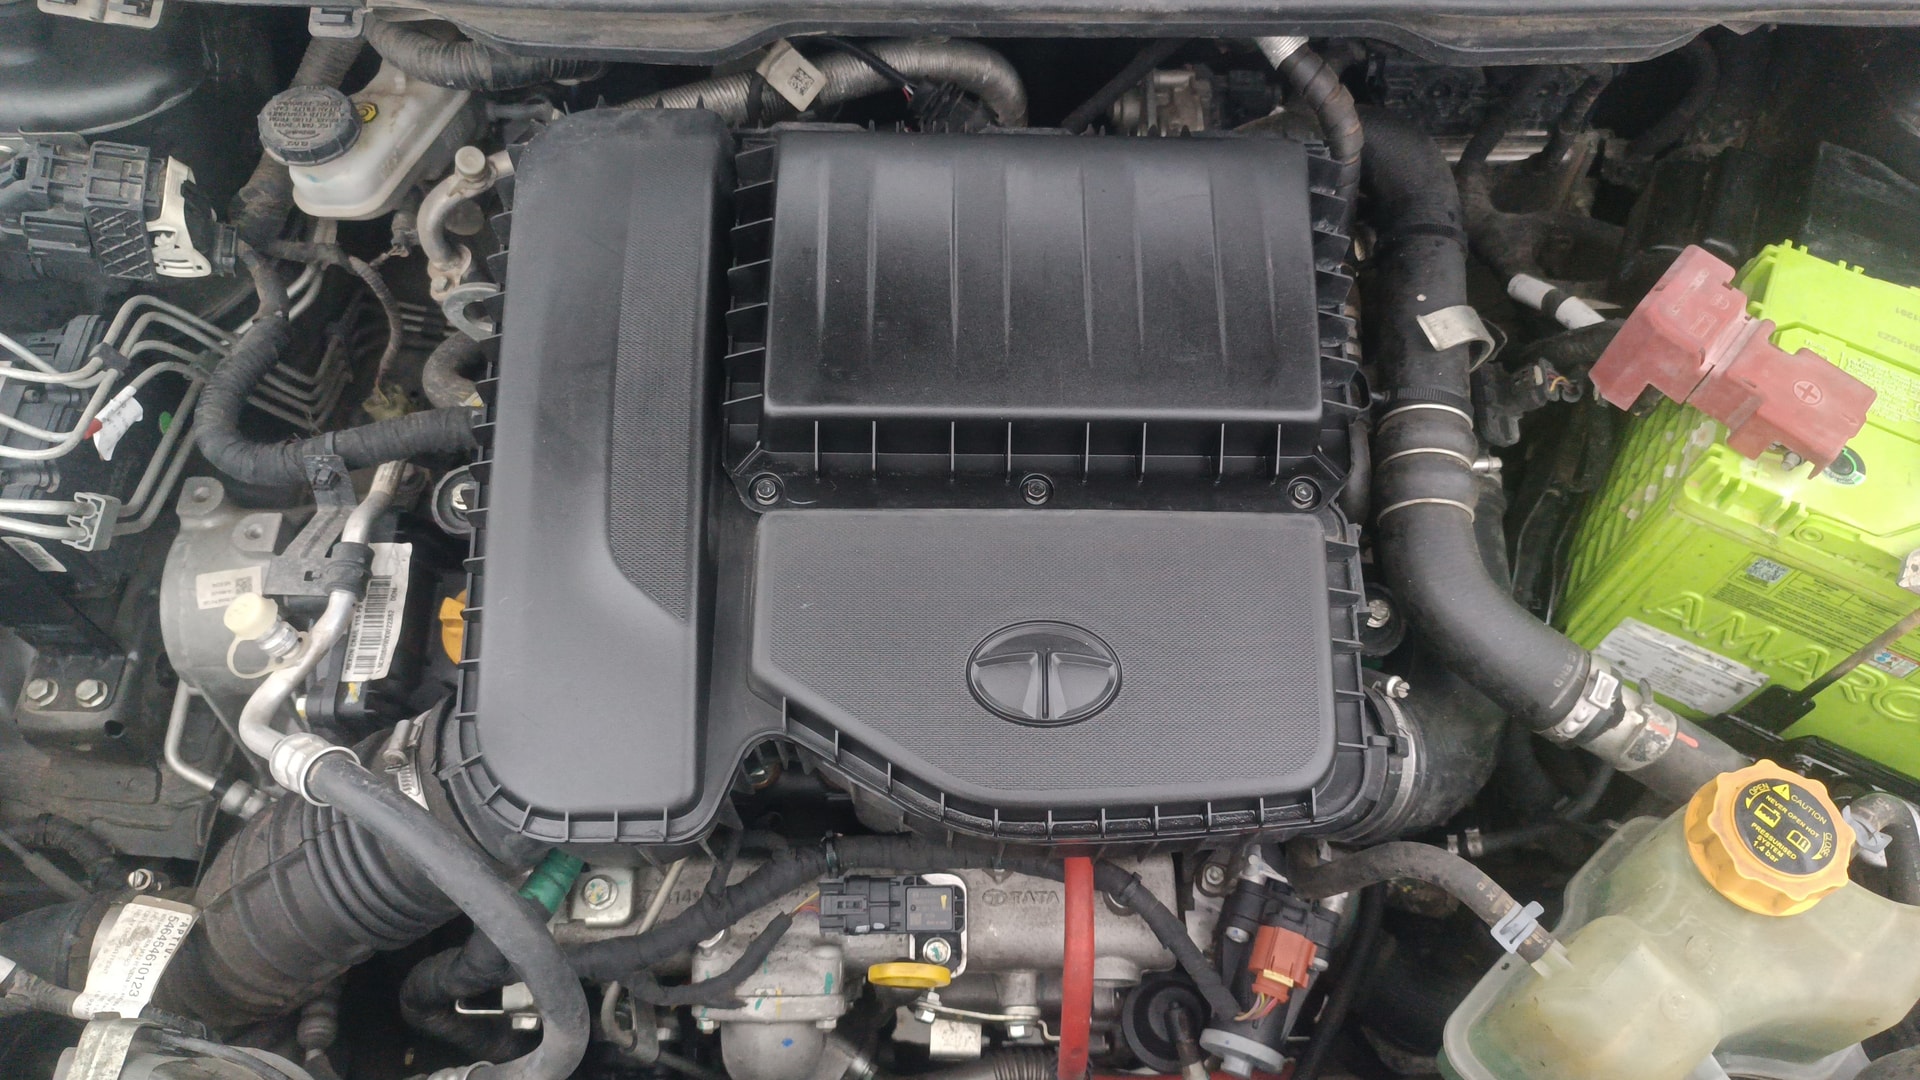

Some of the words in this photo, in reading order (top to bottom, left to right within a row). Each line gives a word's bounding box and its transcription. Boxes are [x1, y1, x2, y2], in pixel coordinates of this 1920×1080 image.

[1748, 783, 1770, 796] OPEN
[1765, 795, 1788, 814] NEVER
[1787, 811, 1807, 828] OPEN
[1805, 824, 1820, 838] HOT
[1791, 794, 1828, 825] CAUTION
[1750, 822, 1797, 860] PRESSURISED
[1753, 840, 1766, 852] 1.4
[1764, 849, 1779, 863] bar
[1756, 834, 1784, 858] SYSTEM
[1821, 832, 1833, 858] CLOSE
[1009, 889, 1061, 905] TATA
[128, 914, 180, 998] 546454610123
